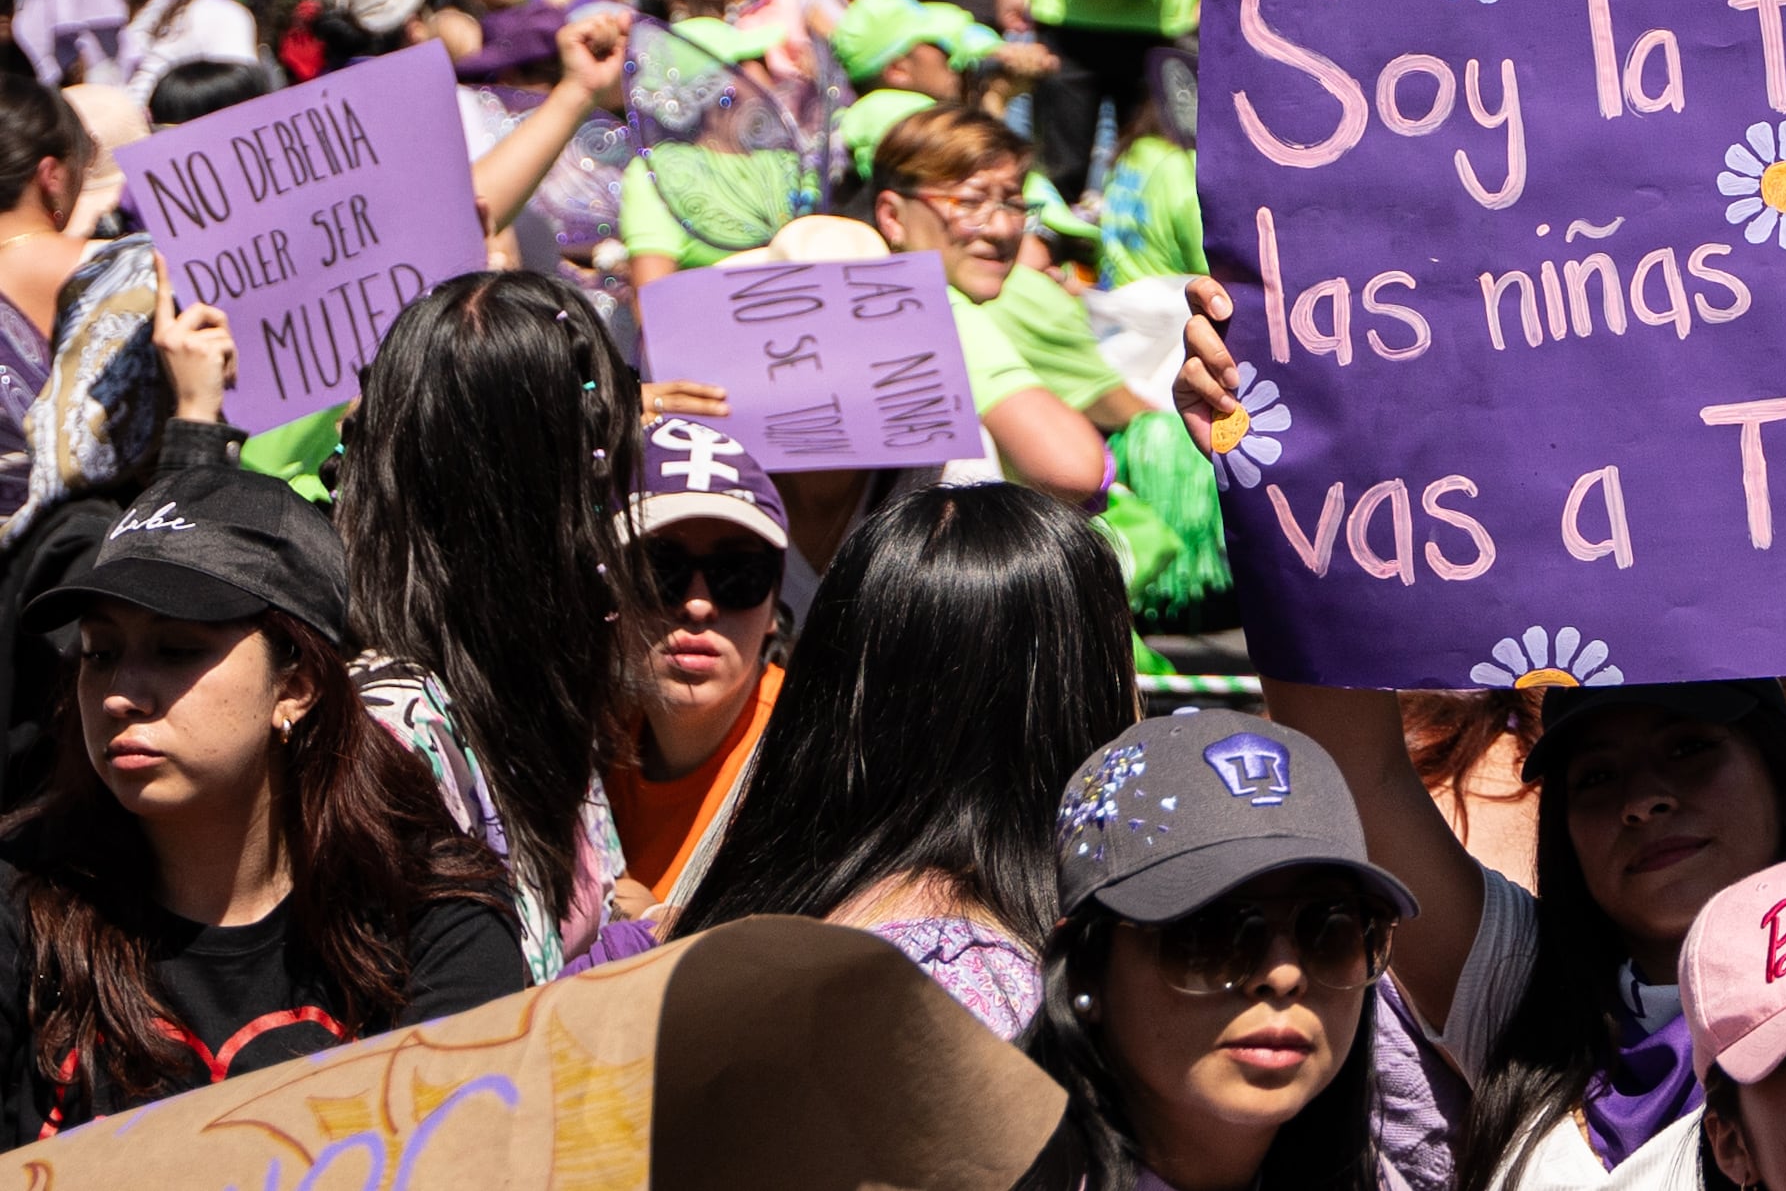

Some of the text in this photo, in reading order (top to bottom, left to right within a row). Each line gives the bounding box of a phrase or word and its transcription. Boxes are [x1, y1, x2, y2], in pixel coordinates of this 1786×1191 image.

[144, 89, 380, 238] NO DEBERÍA
[183, 194, 380, 306] DOLER SER
[723, 264, 824, 323] NO
[1257, 207, 1431, 366] las
[1480, 217, 1752, 351] niñas
[763, 334, 824, 382] SE
[842, 260, 962, 448] LAS NIÑAS
[1267, 475, 1496, 586] vas
[1562, 466, 1634, 568] a
